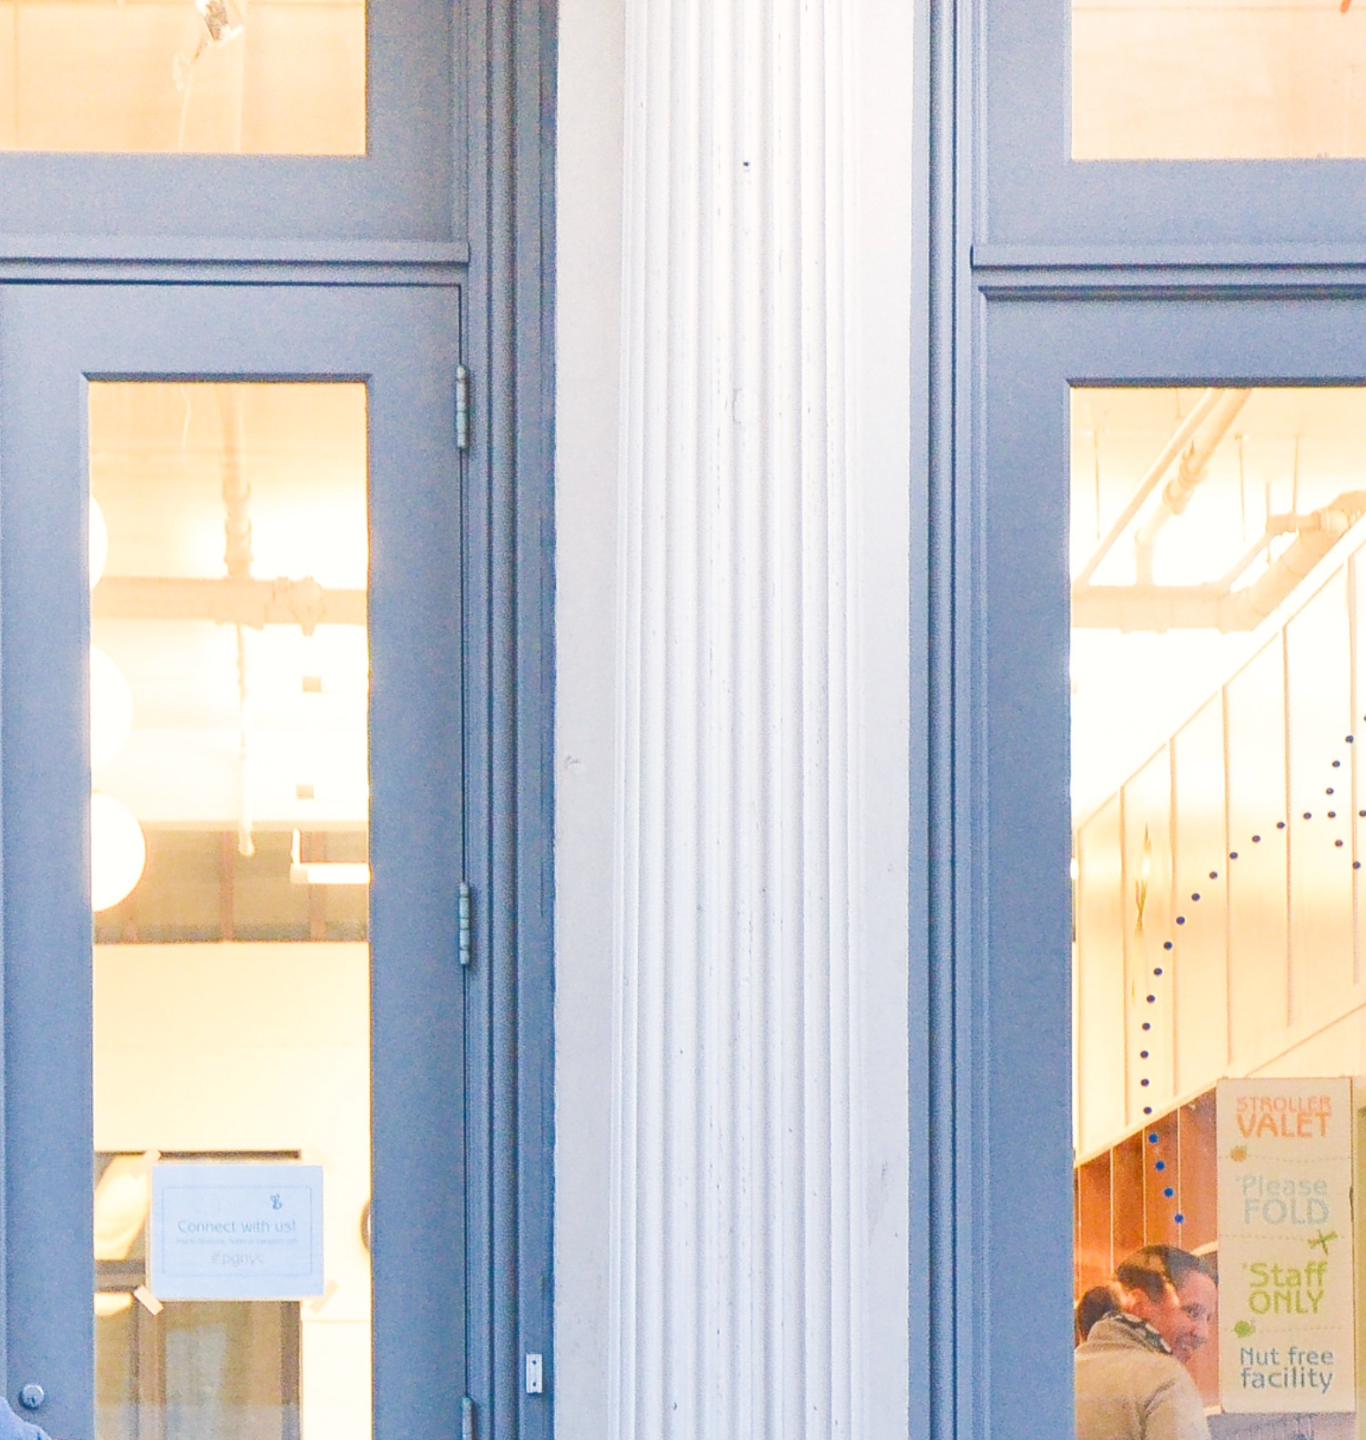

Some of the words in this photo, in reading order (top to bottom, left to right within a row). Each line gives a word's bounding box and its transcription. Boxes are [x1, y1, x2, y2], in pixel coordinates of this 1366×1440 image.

[1237, 1095, 1332, 1114] STROLLER
[1237, 1112, 1331, 1138] VALET
[1242, 1175, 1327, 1196] Please
[1244, 1198, 1330, 1225] FOLD
[177, 1219, 236, 1234] Connect
[241, 1219, 270, 1233] with
[274, 1219, 297, 1233] us!
[1249, 1261, 1328, 1288] Staff
[1248, 1289, 1325, 1315] ONLY
[1240, 1346, 1281, 1366] Nut
[1288, 1345, 1334, 1366] free
[1241, 1366, 1334, 1395] facility
